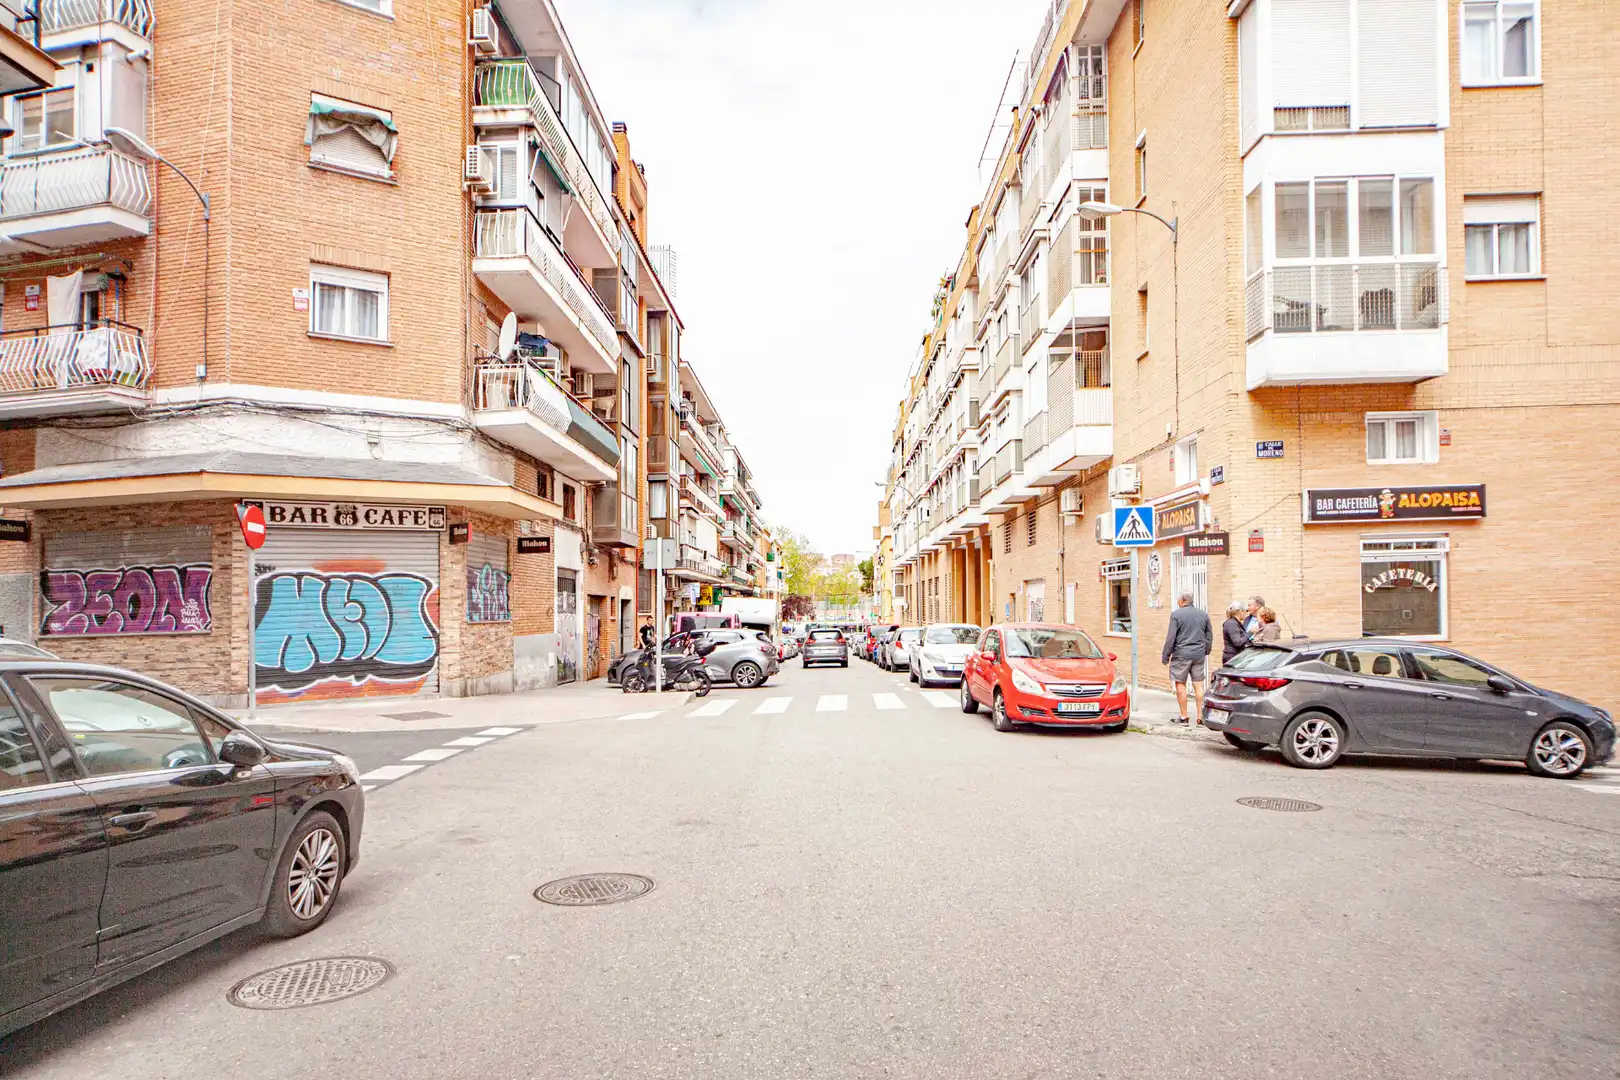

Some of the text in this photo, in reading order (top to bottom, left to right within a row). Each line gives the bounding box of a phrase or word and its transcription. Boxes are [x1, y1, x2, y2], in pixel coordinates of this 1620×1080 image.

[1258, 449, 1284, 457] MORENO
[1316, 495, 1379, 511] BAR CAFETERÍA
[1398, 491, 1481, 508] ALOPAISA
[269, 505, 328, 524] BAR
[339, 513, 354, 526] 66
[364, 509, 427, 526] CAFE
[1161, 507, 1196, 530] ALOPAISA
[1188, 537, 1224, 547] Mahou
[1365, 568, 1438, 593] CAFETERIA
